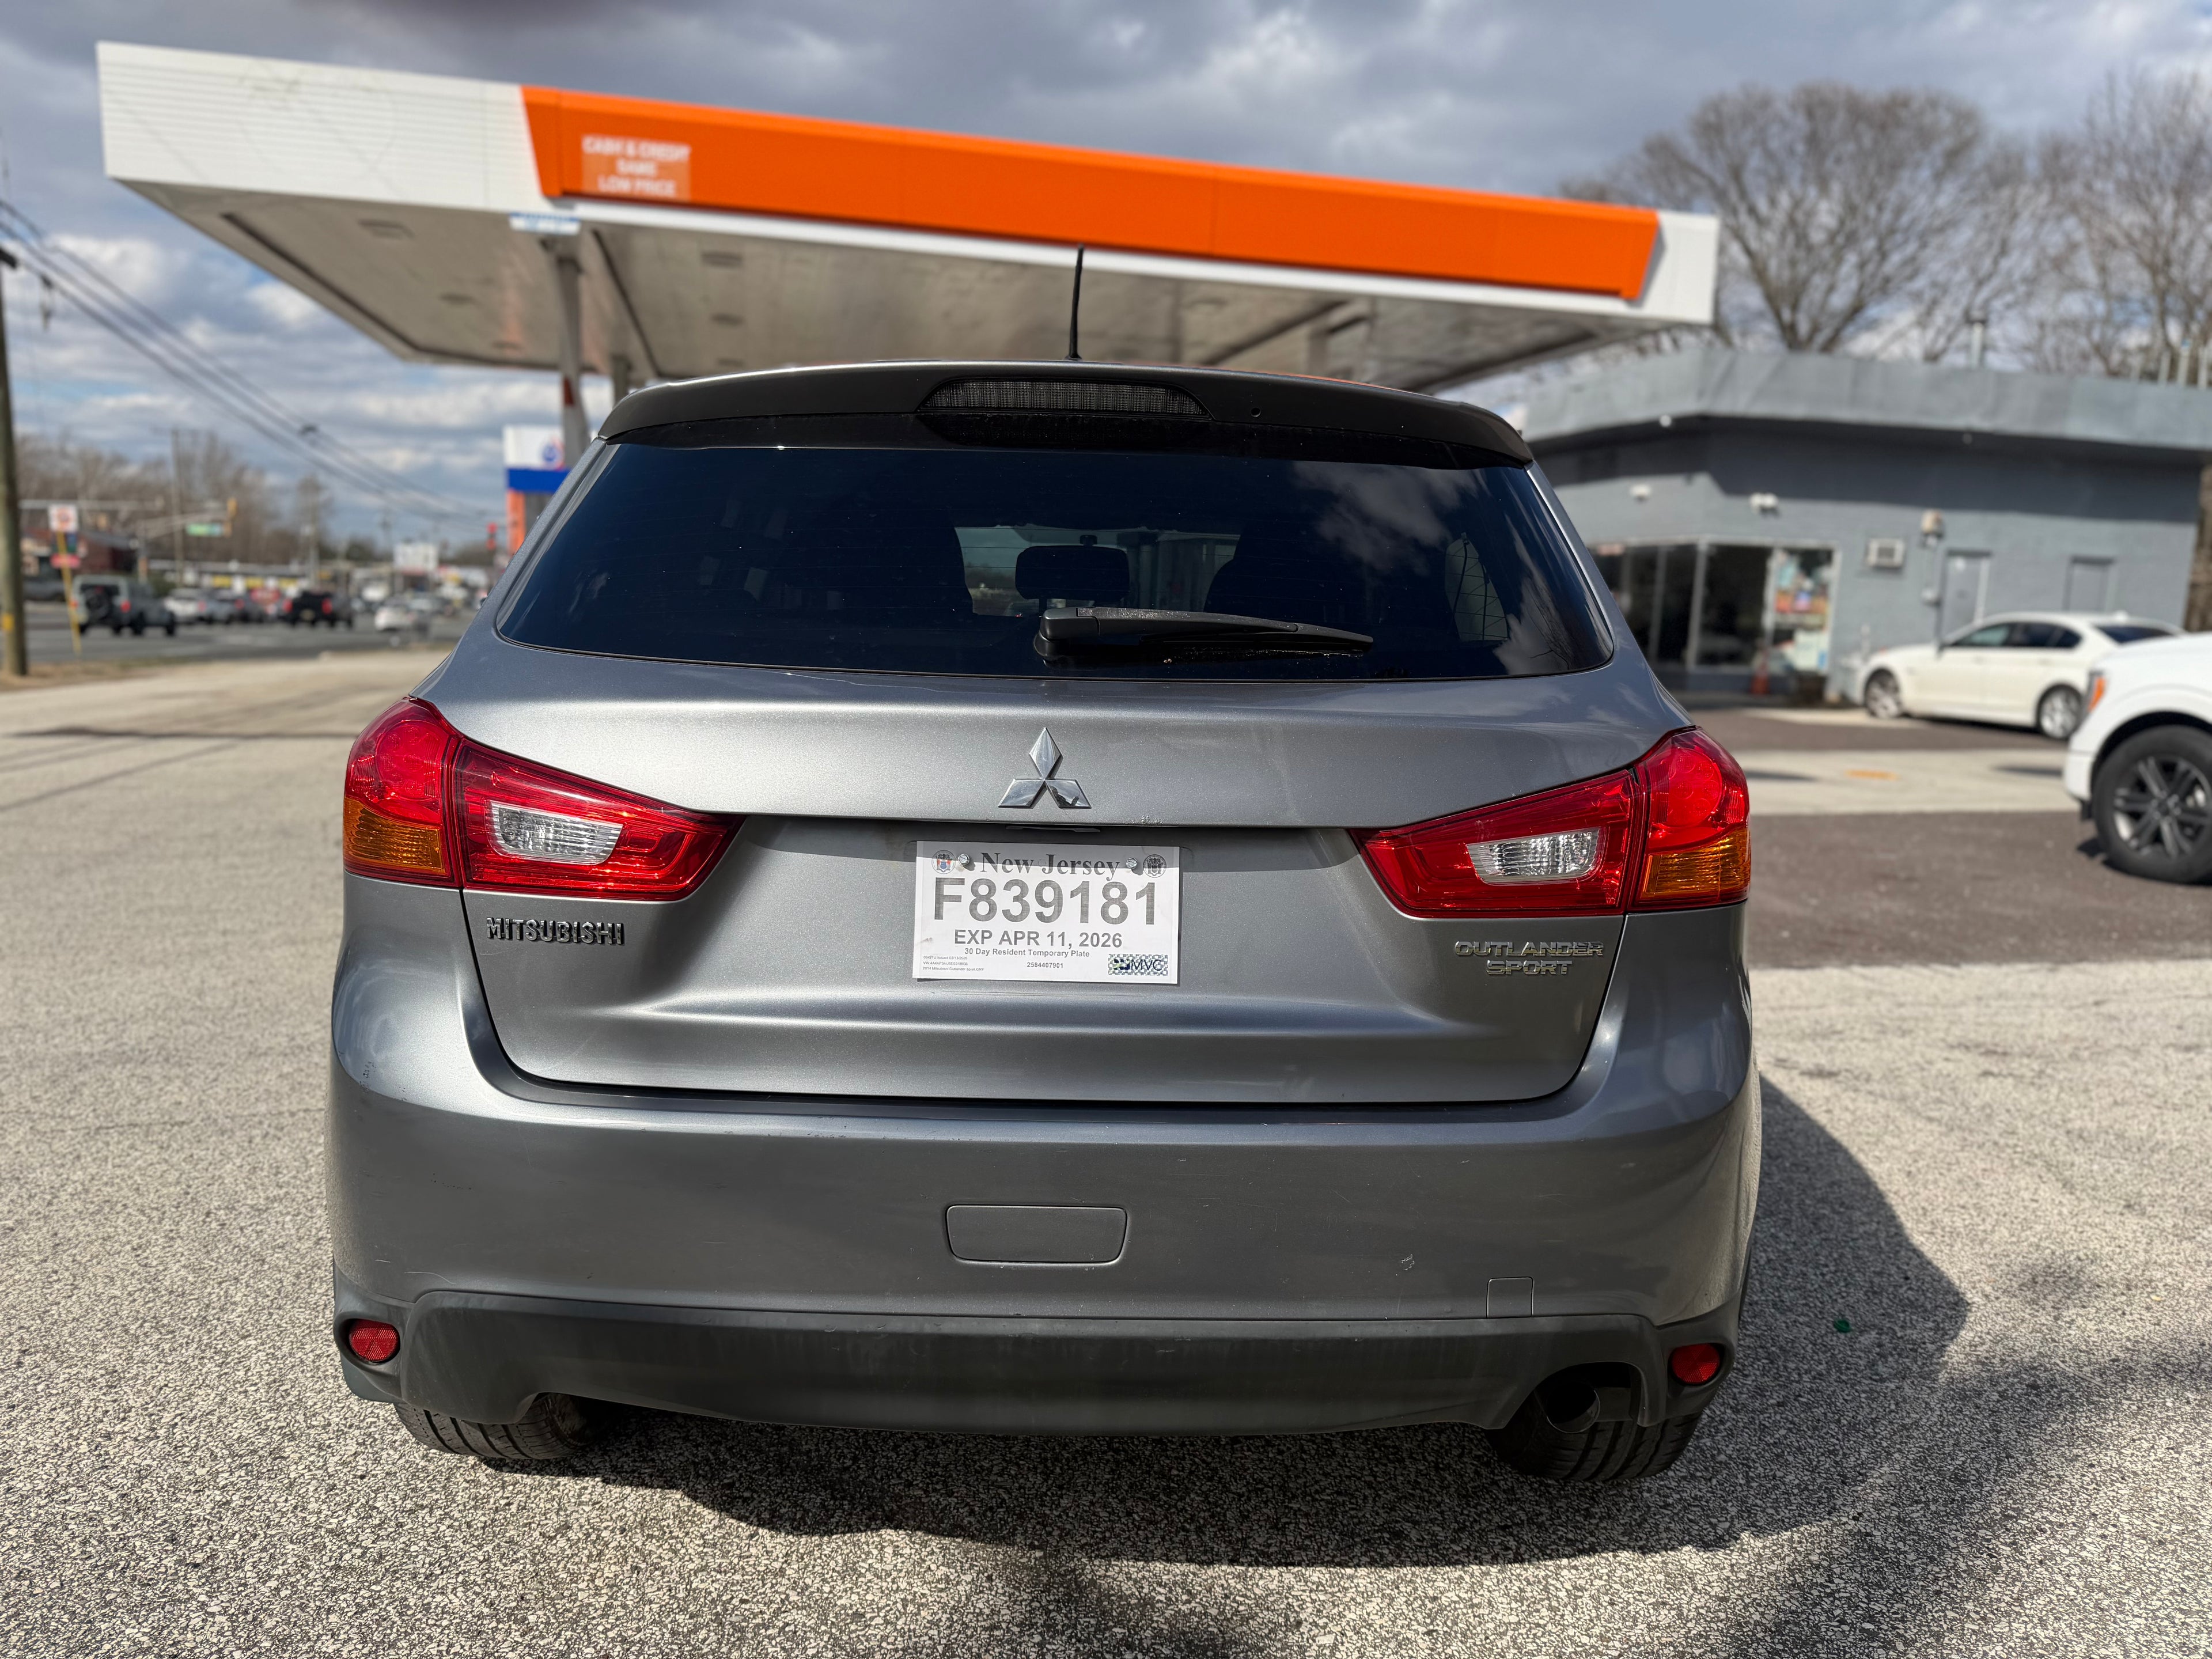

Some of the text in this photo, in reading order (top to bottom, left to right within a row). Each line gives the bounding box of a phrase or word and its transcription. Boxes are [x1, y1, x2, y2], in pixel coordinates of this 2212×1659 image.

[597, 175, 676, 198] LOW PRICE
[980, 853, 1034, 874] New
[1041, 854, 1120, 881] Jersey
[934, 877, 1156, 925] F839181
[486, 917, 624, 945] MITSUBISHI
[955, 929, 1122, 949] EXP APR 11, 2026
[975, 948, 990, 956] Day
[1028, 949, 1069, 958] Temporary
[1455, 941, 1604, 956] OUTLANDER
[1131, 959, 1162, 971] MVC
[1486, 960, 1573, 975] SPORT
